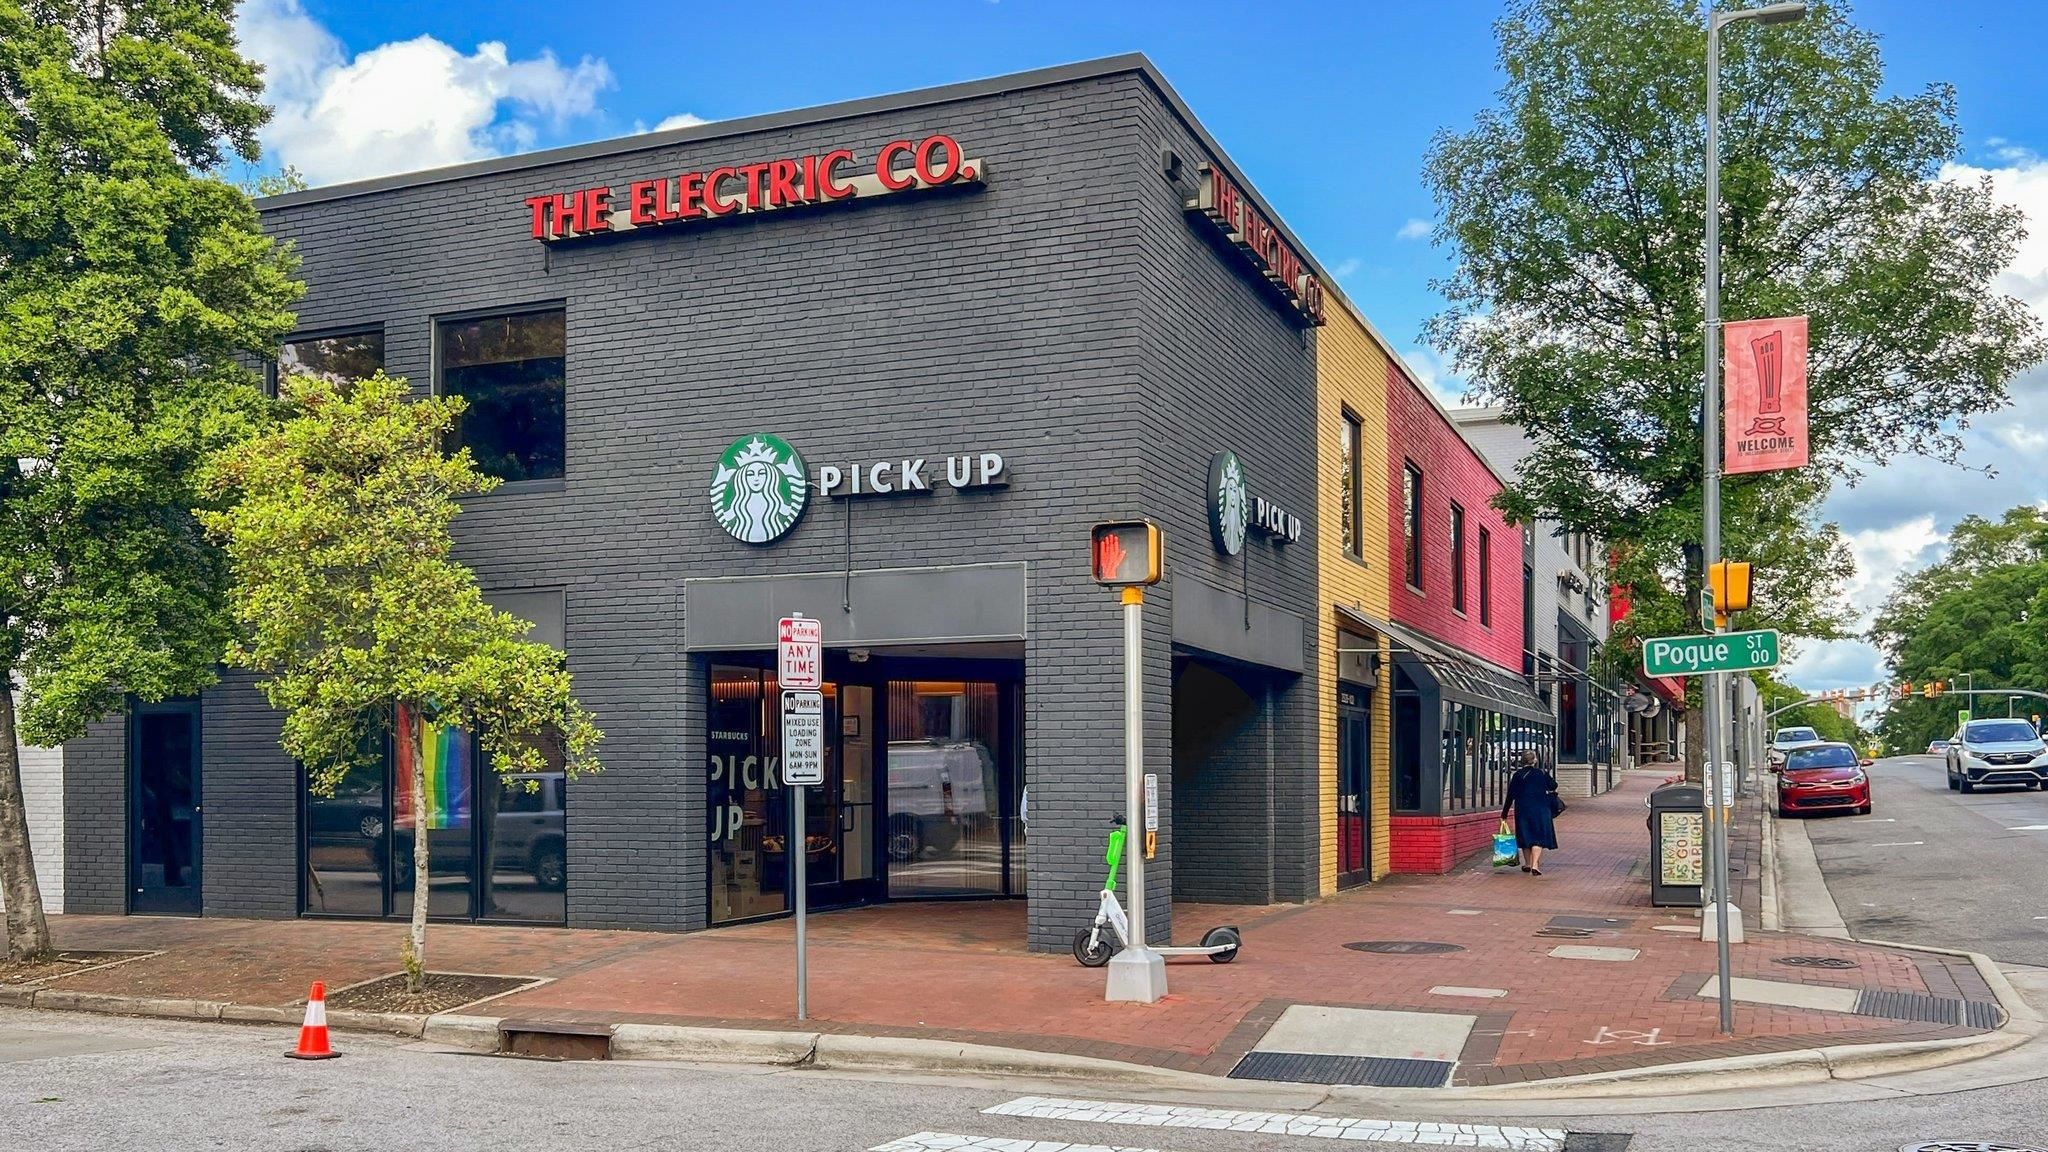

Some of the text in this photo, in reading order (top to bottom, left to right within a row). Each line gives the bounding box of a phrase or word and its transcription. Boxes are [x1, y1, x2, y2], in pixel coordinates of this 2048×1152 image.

[525, 134, 976, 240] THE ELECTRIC CO.
[1208, 164, 1239, 233] THE
[1244, 203, 1303, 299] ELECTRIC
[1737, 437, 1795, 452] WELCOME
[820, 454, 1004, 496] PICK UP
[1257, 497, 1301, 542] PICK UP
[781, 625, 818, 638] NO PARKING
[787, 645, 812, 657] ANY
[1653, 634, 1763, 670] Pogue ST
[1751, 650, 1769, 664] 00
[786, 660, 814, 673] TIME
[784, 697, 820, 710] NO PARKING
[786, 718, 820, 727] MIXED USE
[711, 731, 748, 740] STARBUCKS
[789, 729, 817, 737] LOADING
[711, 755, 778, 790] PICK
[1676, 816, 1689, 859] GOING
